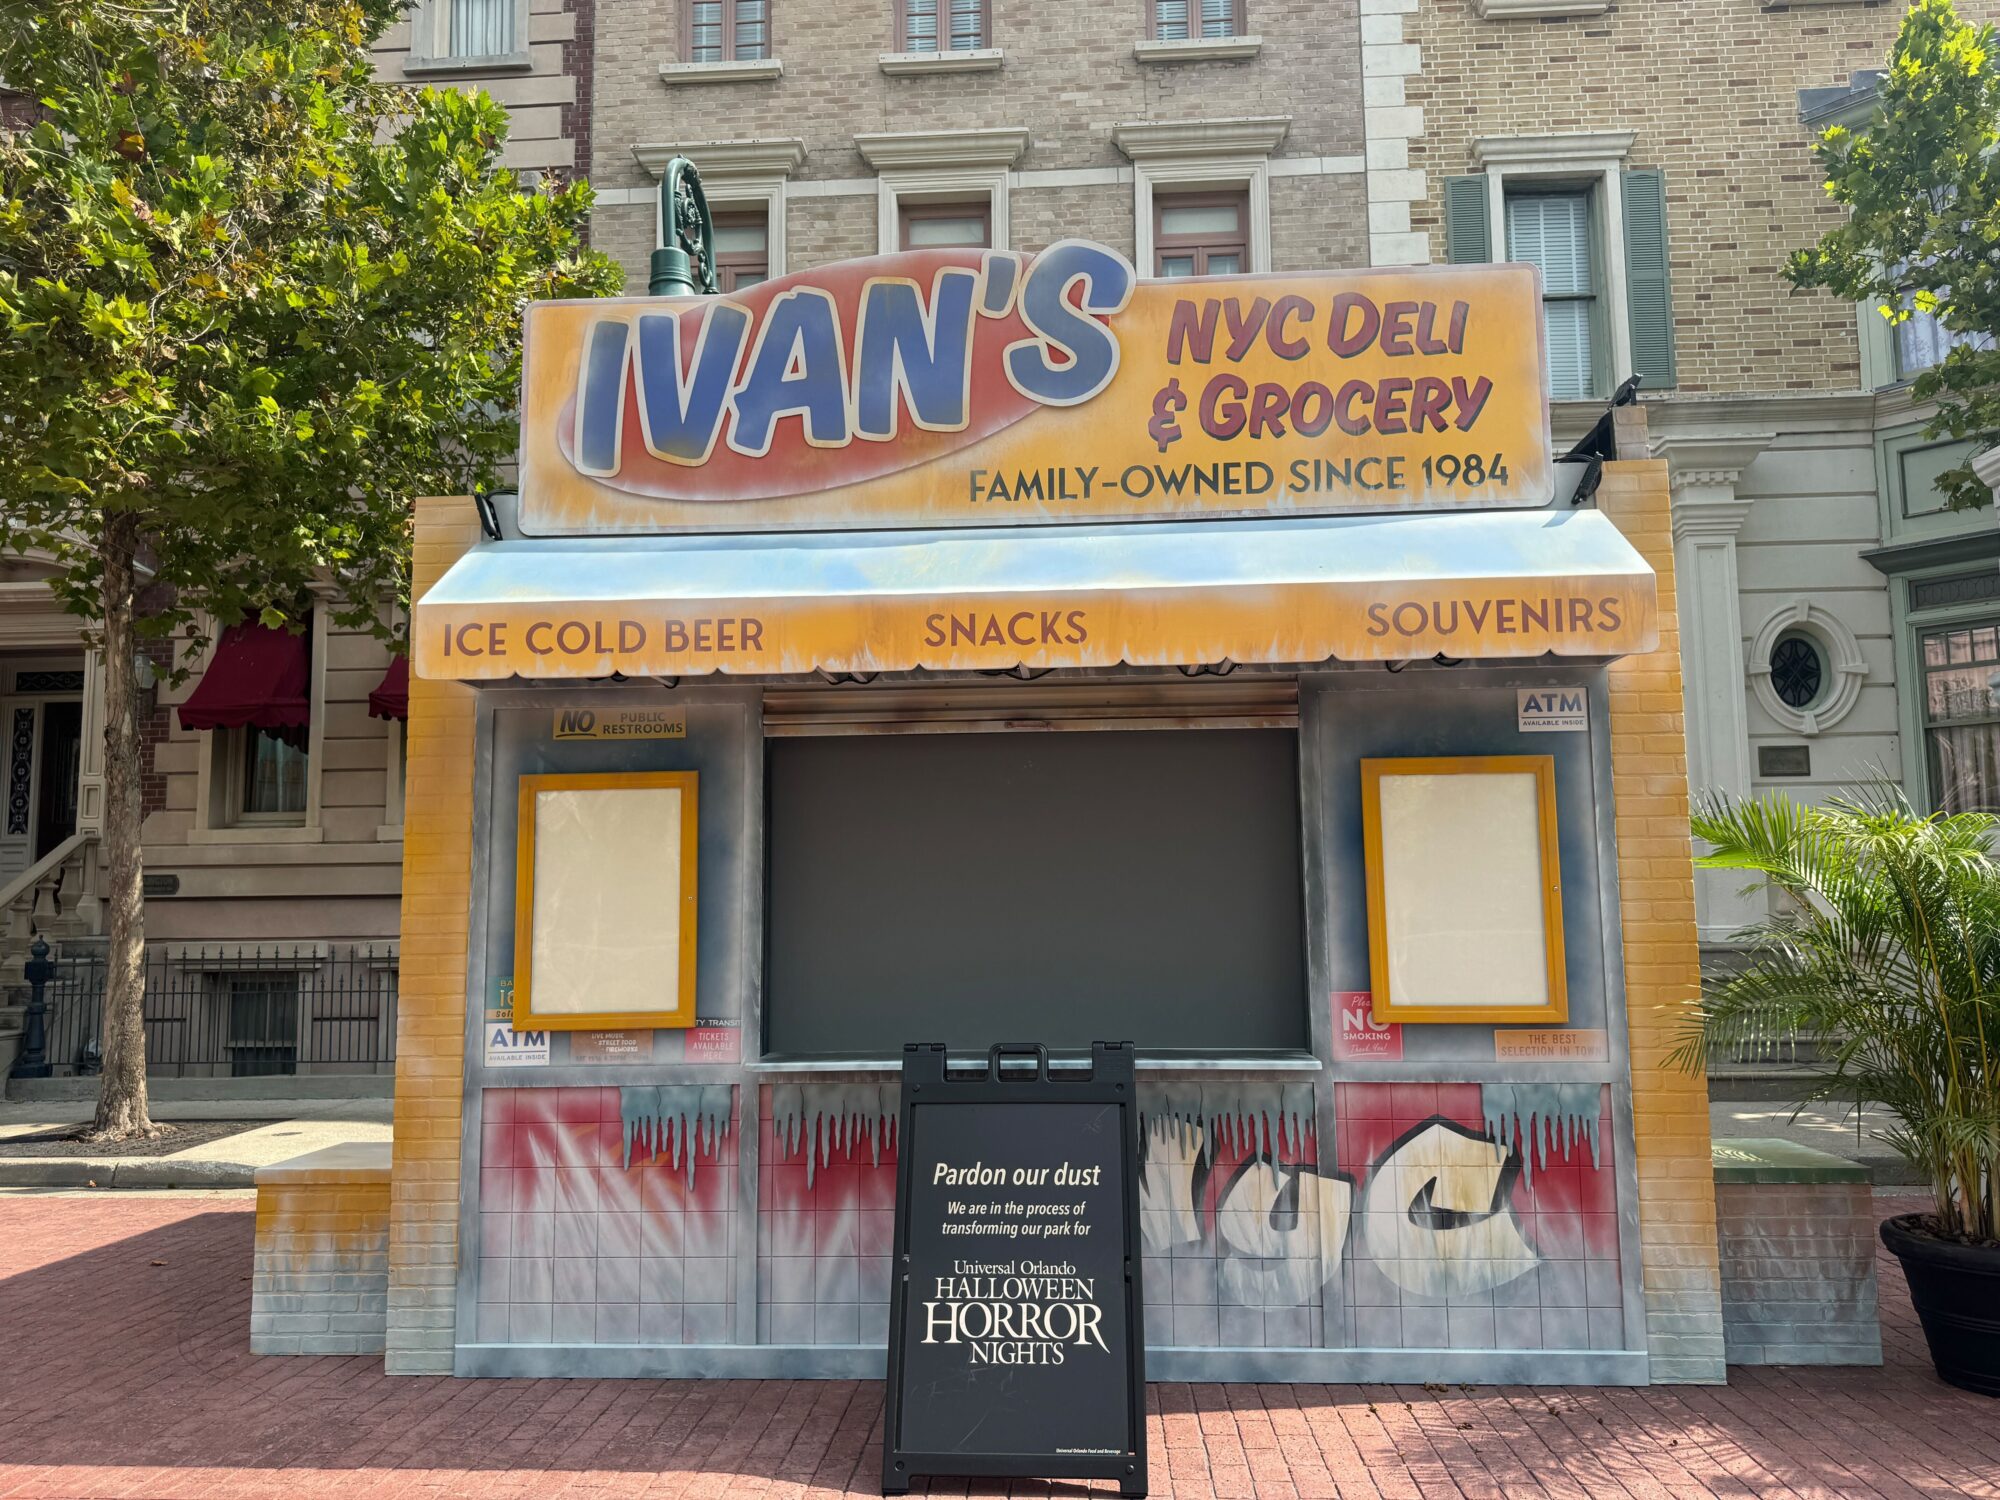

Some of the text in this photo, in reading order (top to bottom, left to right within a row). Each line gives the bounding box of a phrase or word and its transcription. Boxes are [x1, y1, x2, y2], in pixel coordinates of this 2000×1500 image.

[1166, 292, 1469, 365] NYC DELI
[575, 240, 1137, 477] IVAN'S
[1147, 374, 1493, 452] & GROCERY
[970, 453, 1509, 503] FAMILY-OWNED SINCE 1984
[1366, 598, 1622, 638] SOUVENIRS
[443, 618, 764, 656] ICE COLD BEER
[923, 611, 1088, 647] SNACKS
[1523, 693, 1582, 713] ATM
[560, 710, 595, 733] NO
[620, 712, 665, 723] PUBLIC
[602, 722, 683, 735] RESTROOMS
[490, 1028, 546, 1048] ATM
[692, 1041, 734, 1050] AVAILABLE
[698, 1032, 729, 1041] TICKETS
[1343, 1032, 1391, 1040] SMOKING
[1528, 1033, 1577, 1044] THE BEST
[703, 1051, 723, 1060] HERE
[1501, 1045, 1602, 1056] SELECTION IN TOWN
[933, 1161, 1101, 1187] Pardon our dust
[948, 1201, 1087, 1218] We are in the process of
[942, 1221, 1091, 1239] transforming our park for
[953, 1259, 1076, 1275] Universal Orlando
[935, 1277, 1095, 1300] HALLOWEEN
[921, 1302, 1110, 1354] HORROR
[969, 1341, 1065, 1365] NIGHTS
